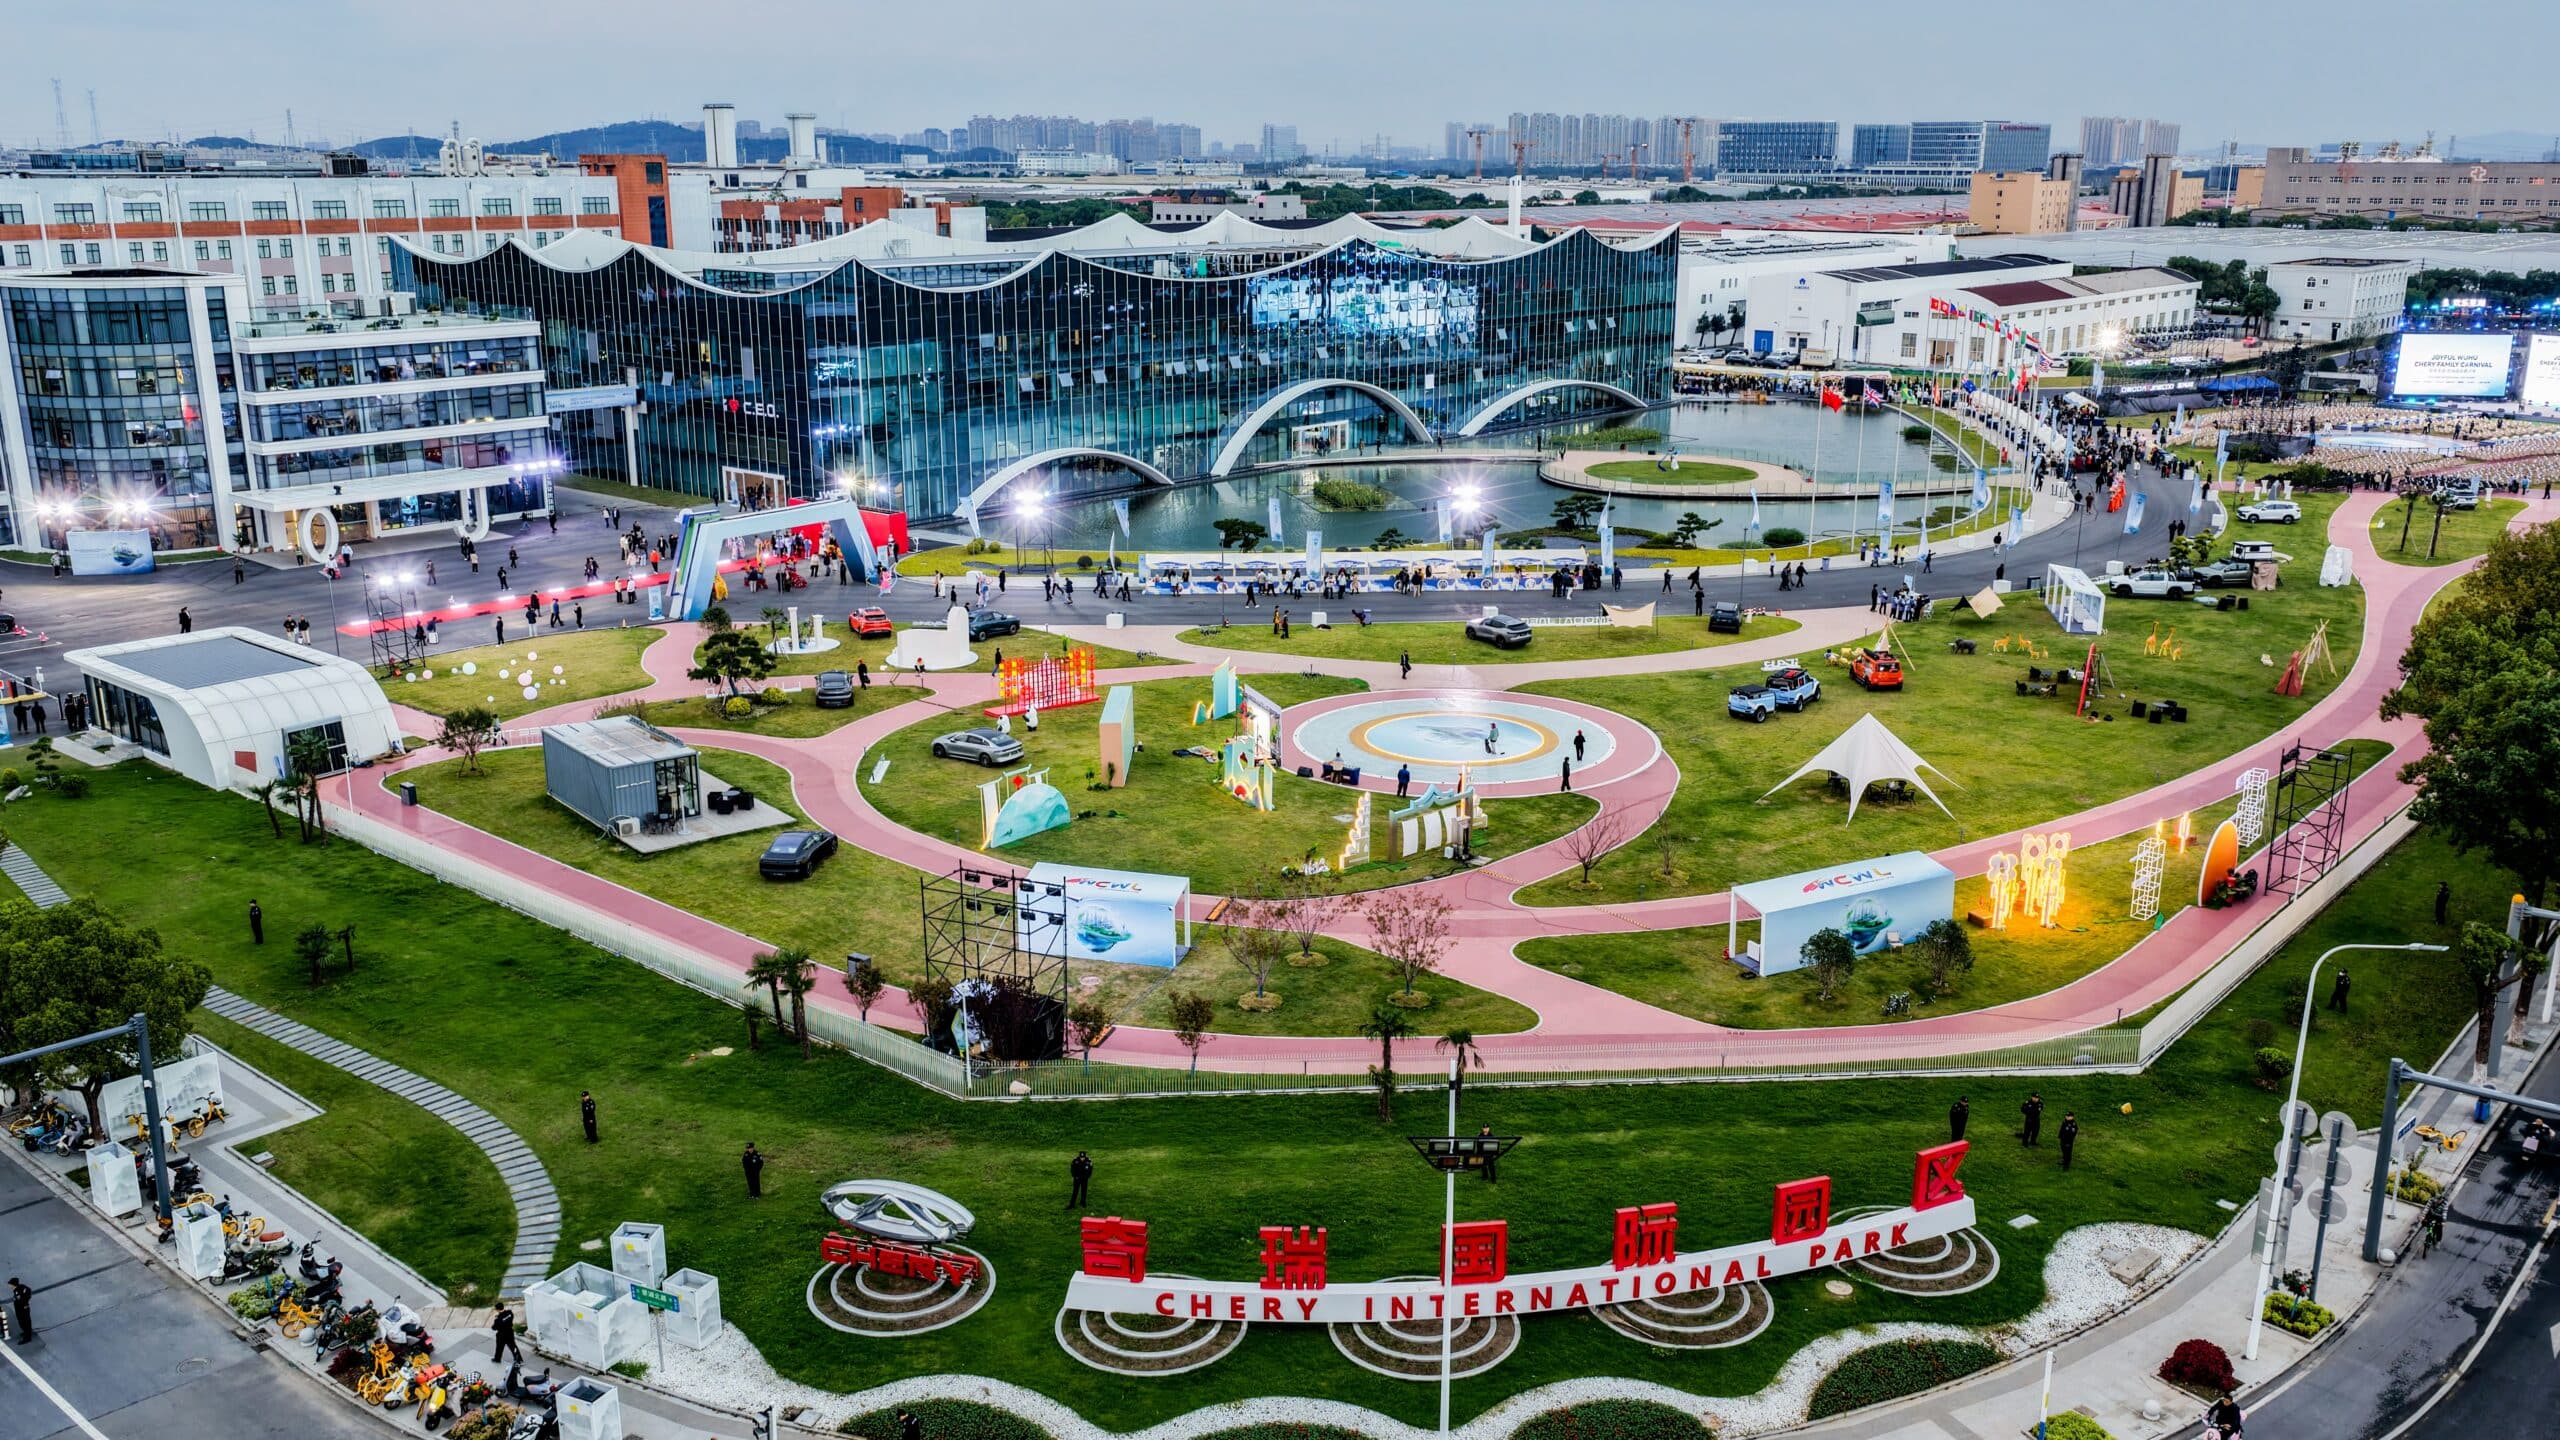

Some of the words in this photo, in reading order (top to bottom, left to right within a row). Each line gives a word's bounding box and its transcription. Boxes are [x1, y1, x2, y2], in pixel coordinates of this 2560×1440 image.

[743, 401, 780, 419] C.E.O.
[821, 1232, 982, 1287] CHERY
[1155, 1292, 1318, 1321] CHERY
[1365, 1255, 1772, 1321] INTERNATIONAL
[1809, 1222, 1909, 1268] PARK
